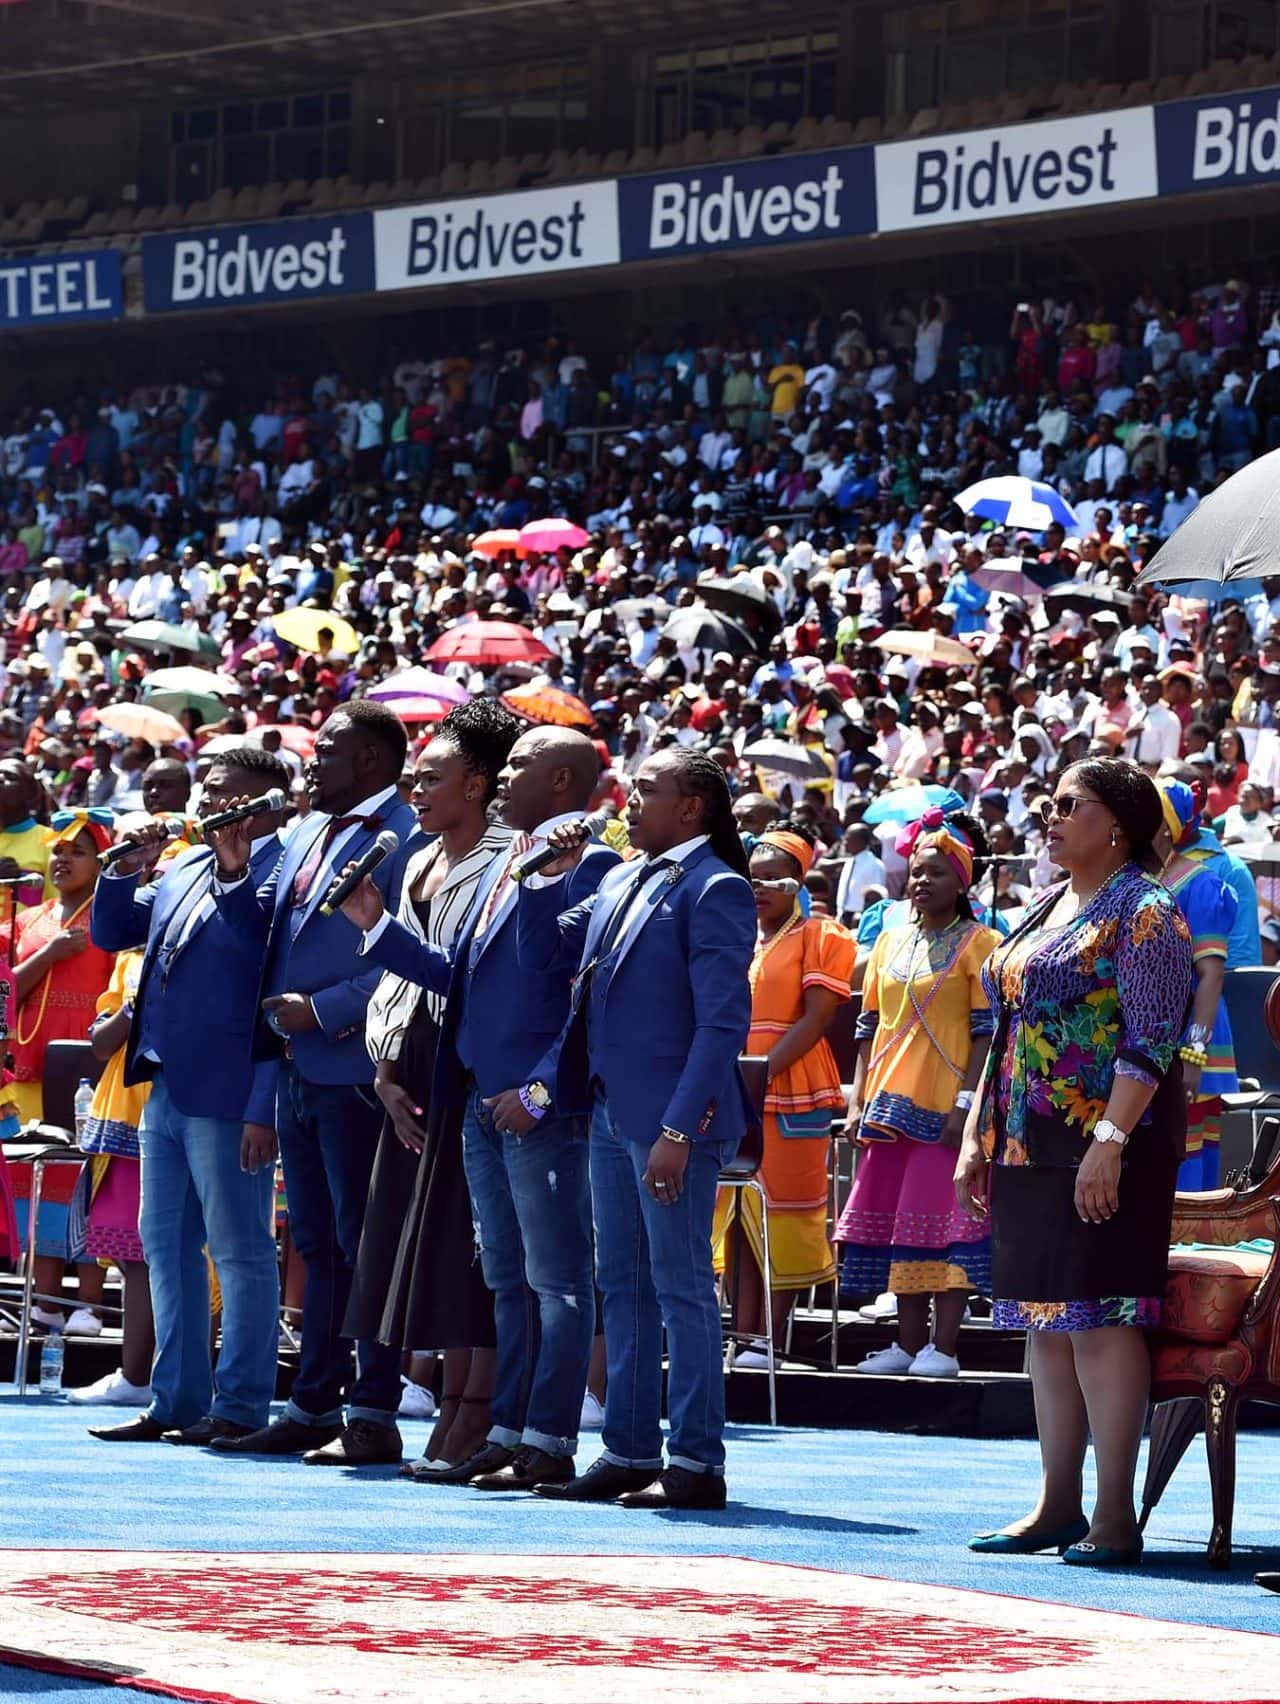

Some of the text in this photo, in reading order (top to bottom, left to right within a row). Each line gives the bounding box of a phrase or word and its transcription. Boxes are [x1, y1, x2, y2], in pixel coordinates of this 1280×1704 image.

[649, 165, 843, 249] Bidvest
[913, 128, 1118, 216] Bidvest
[172, 227, 346, 302] Bidvest
[407, 200, 585, 277] Bidvest
[0, 260, 112, 318] TEEL
